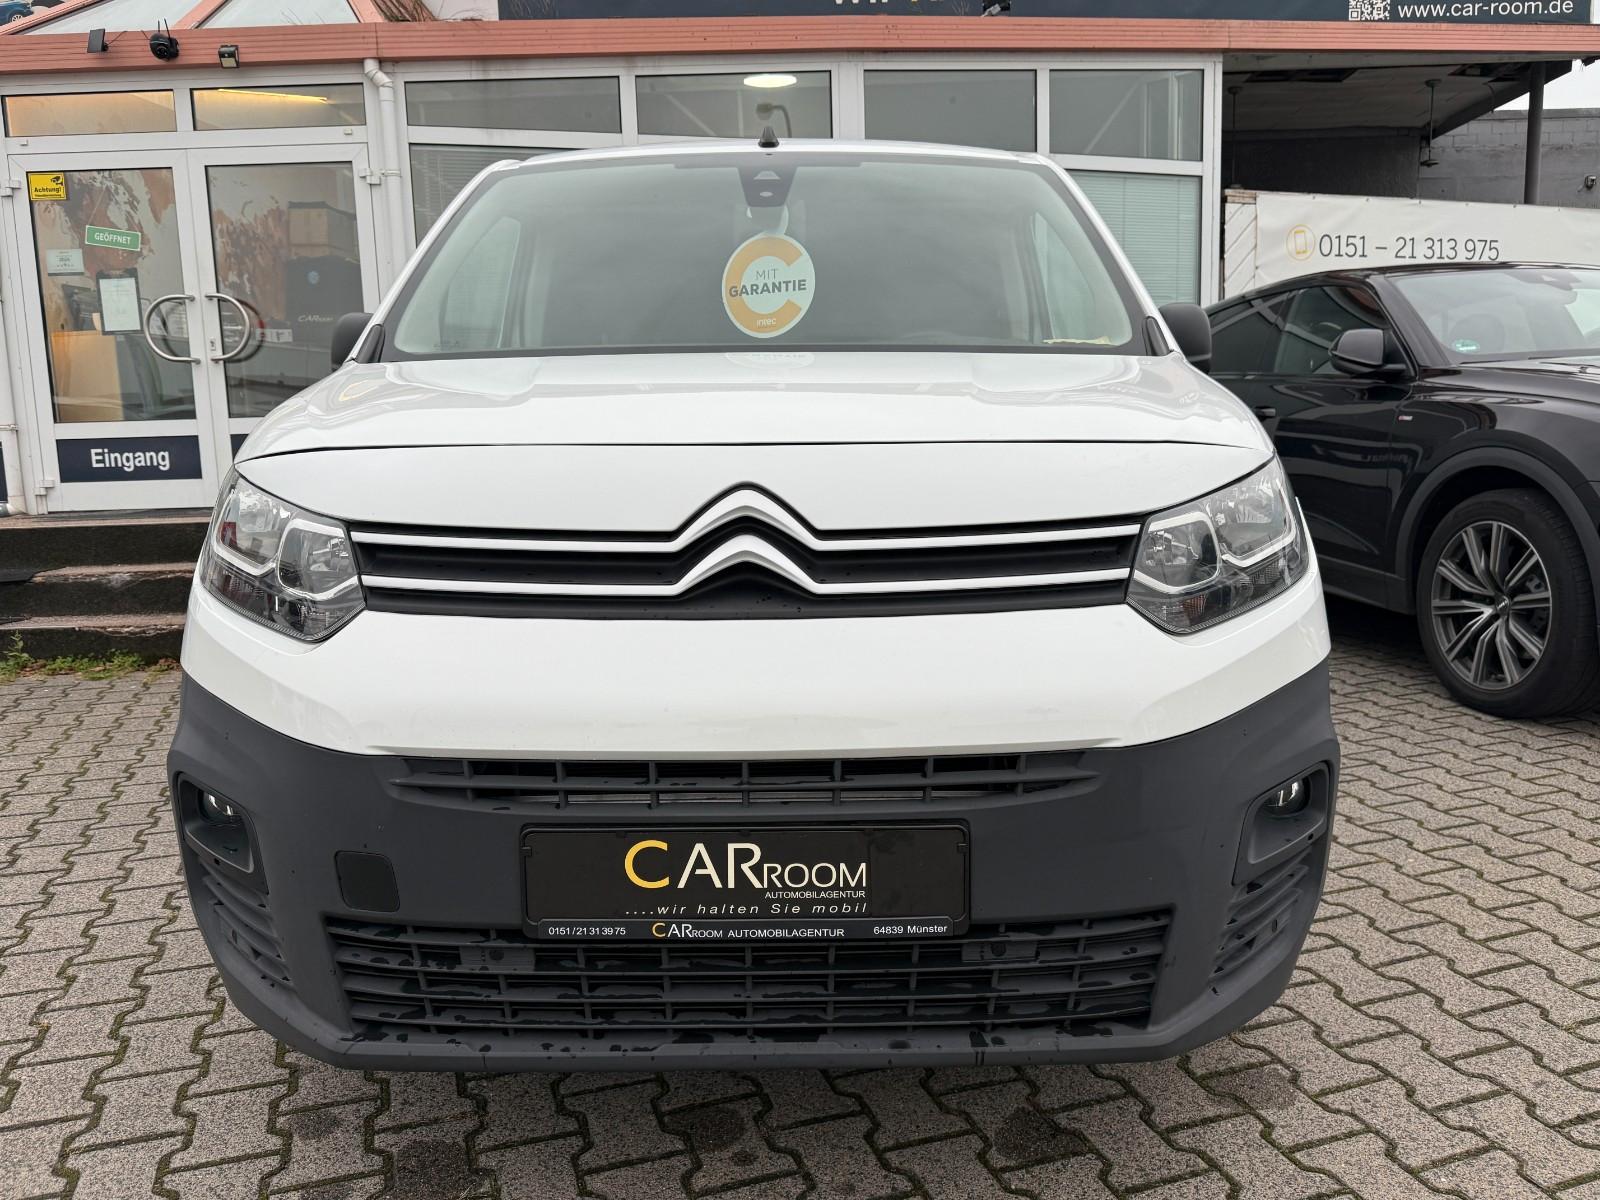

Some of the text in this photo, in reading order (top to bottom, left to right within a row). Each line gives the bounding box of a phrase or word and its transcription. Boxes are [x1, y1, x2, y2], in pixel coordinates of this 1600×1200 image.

[1397, 0, 1573, 18] www.car-room.de
[94, 232, 132, 245] GEÖFFNET
[1319, 234, 1367, 258] 0151
[1394, 236, 1416, 259] 21
[1423, 237, 1457, 260] 313
[1464, 239, 1500, 262] 975
[755, 268, 778, 280] MIT
[728, 279, 807, 298] GARANTIE
[90, 449, 170, 472] Eingang
[765, 891, 867, 899] AUTOMOBILAGENTUR
[697, 903, 759, 915] halten
[770, 903, 801, 914] Sie
[812, 903, 867, 914] mobil
[728, 928, 845, 938] AUTOMOBILAGENTUR
[873, 926, 904, 935] 64839
[907, 924, 948, 935] Münster
